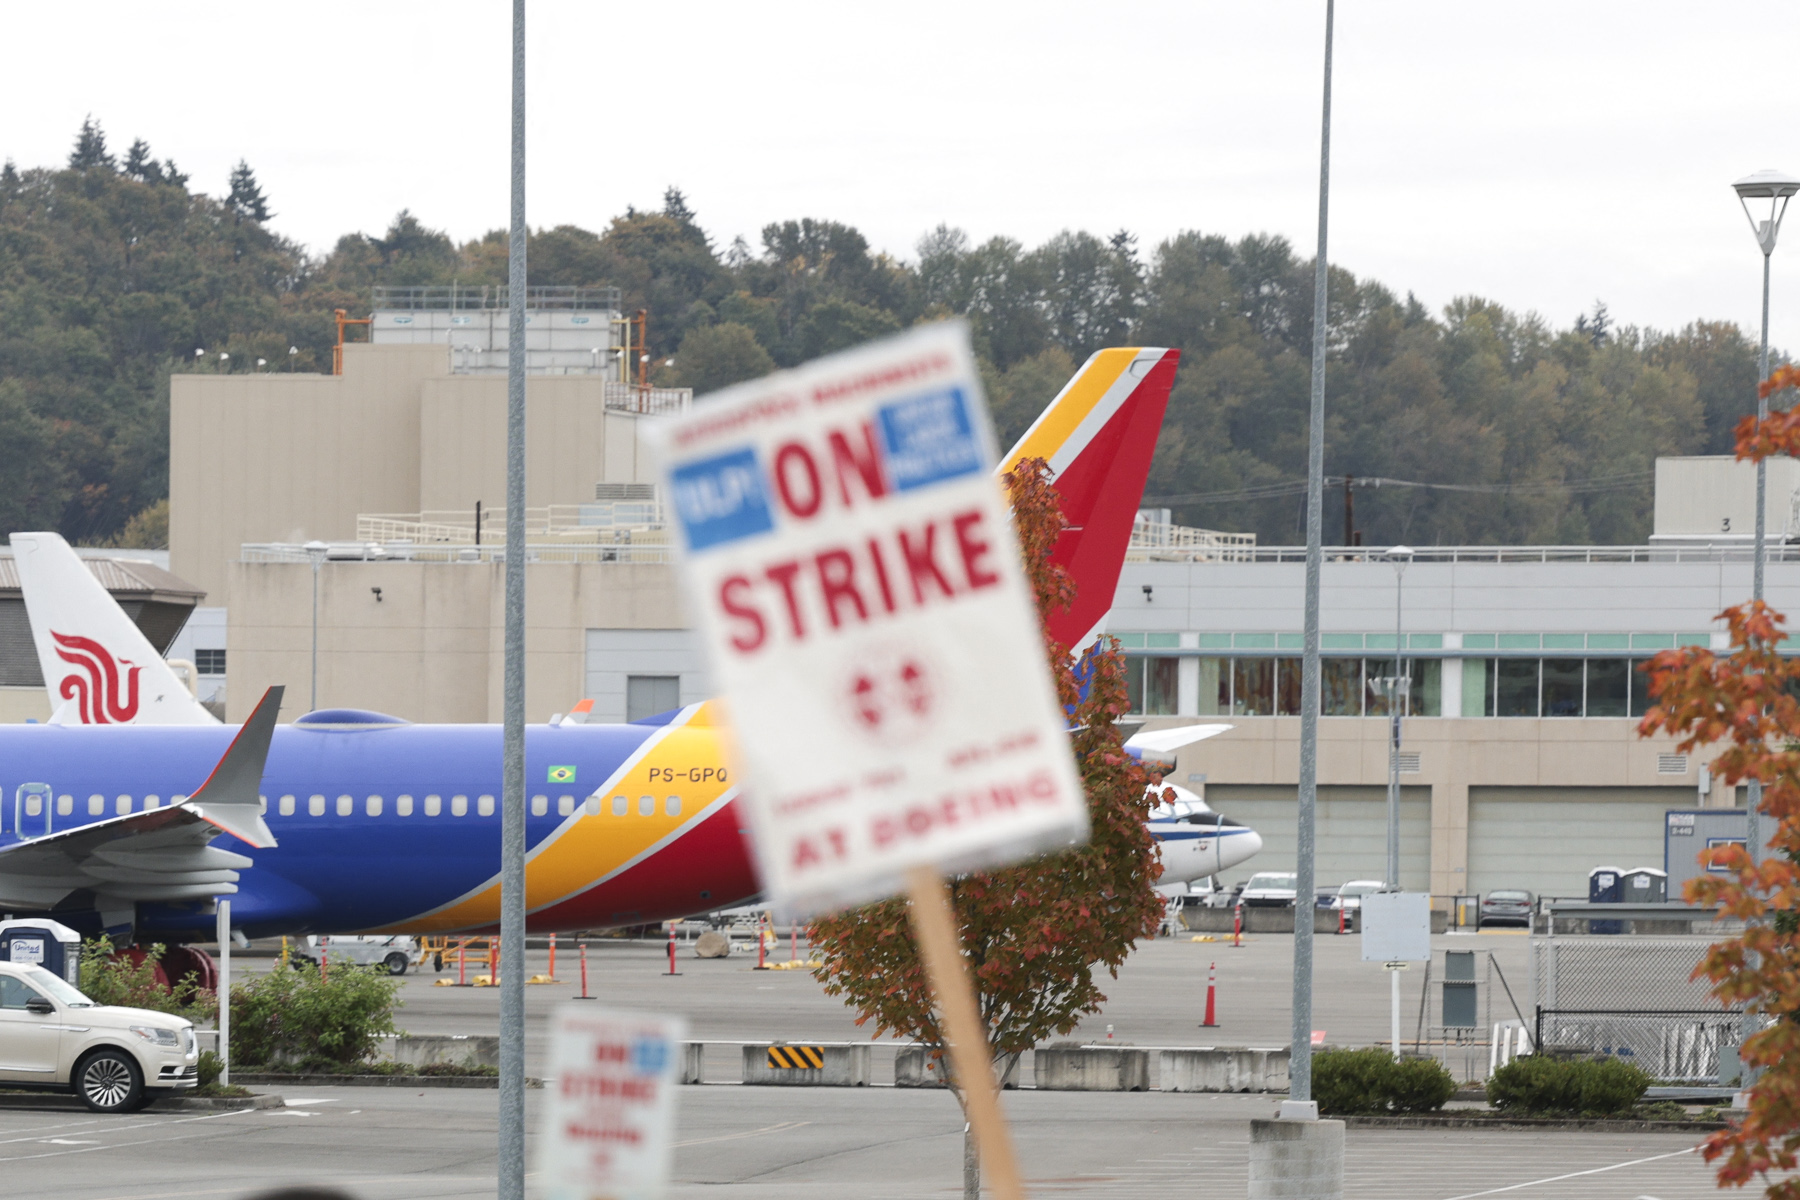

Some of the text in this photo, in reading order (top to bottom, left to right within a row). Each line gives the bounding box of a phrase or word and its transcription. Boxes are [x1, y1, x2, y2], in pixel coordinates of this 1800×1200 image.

[773, 417, 890, 520] ON
[1721, 517, 1731, 532] 3
[718, 509, 1003, 656] STRIKE
[649, 767, 728, 783] PS-GPQ
[870, 768, 1058, 849] BOEING
